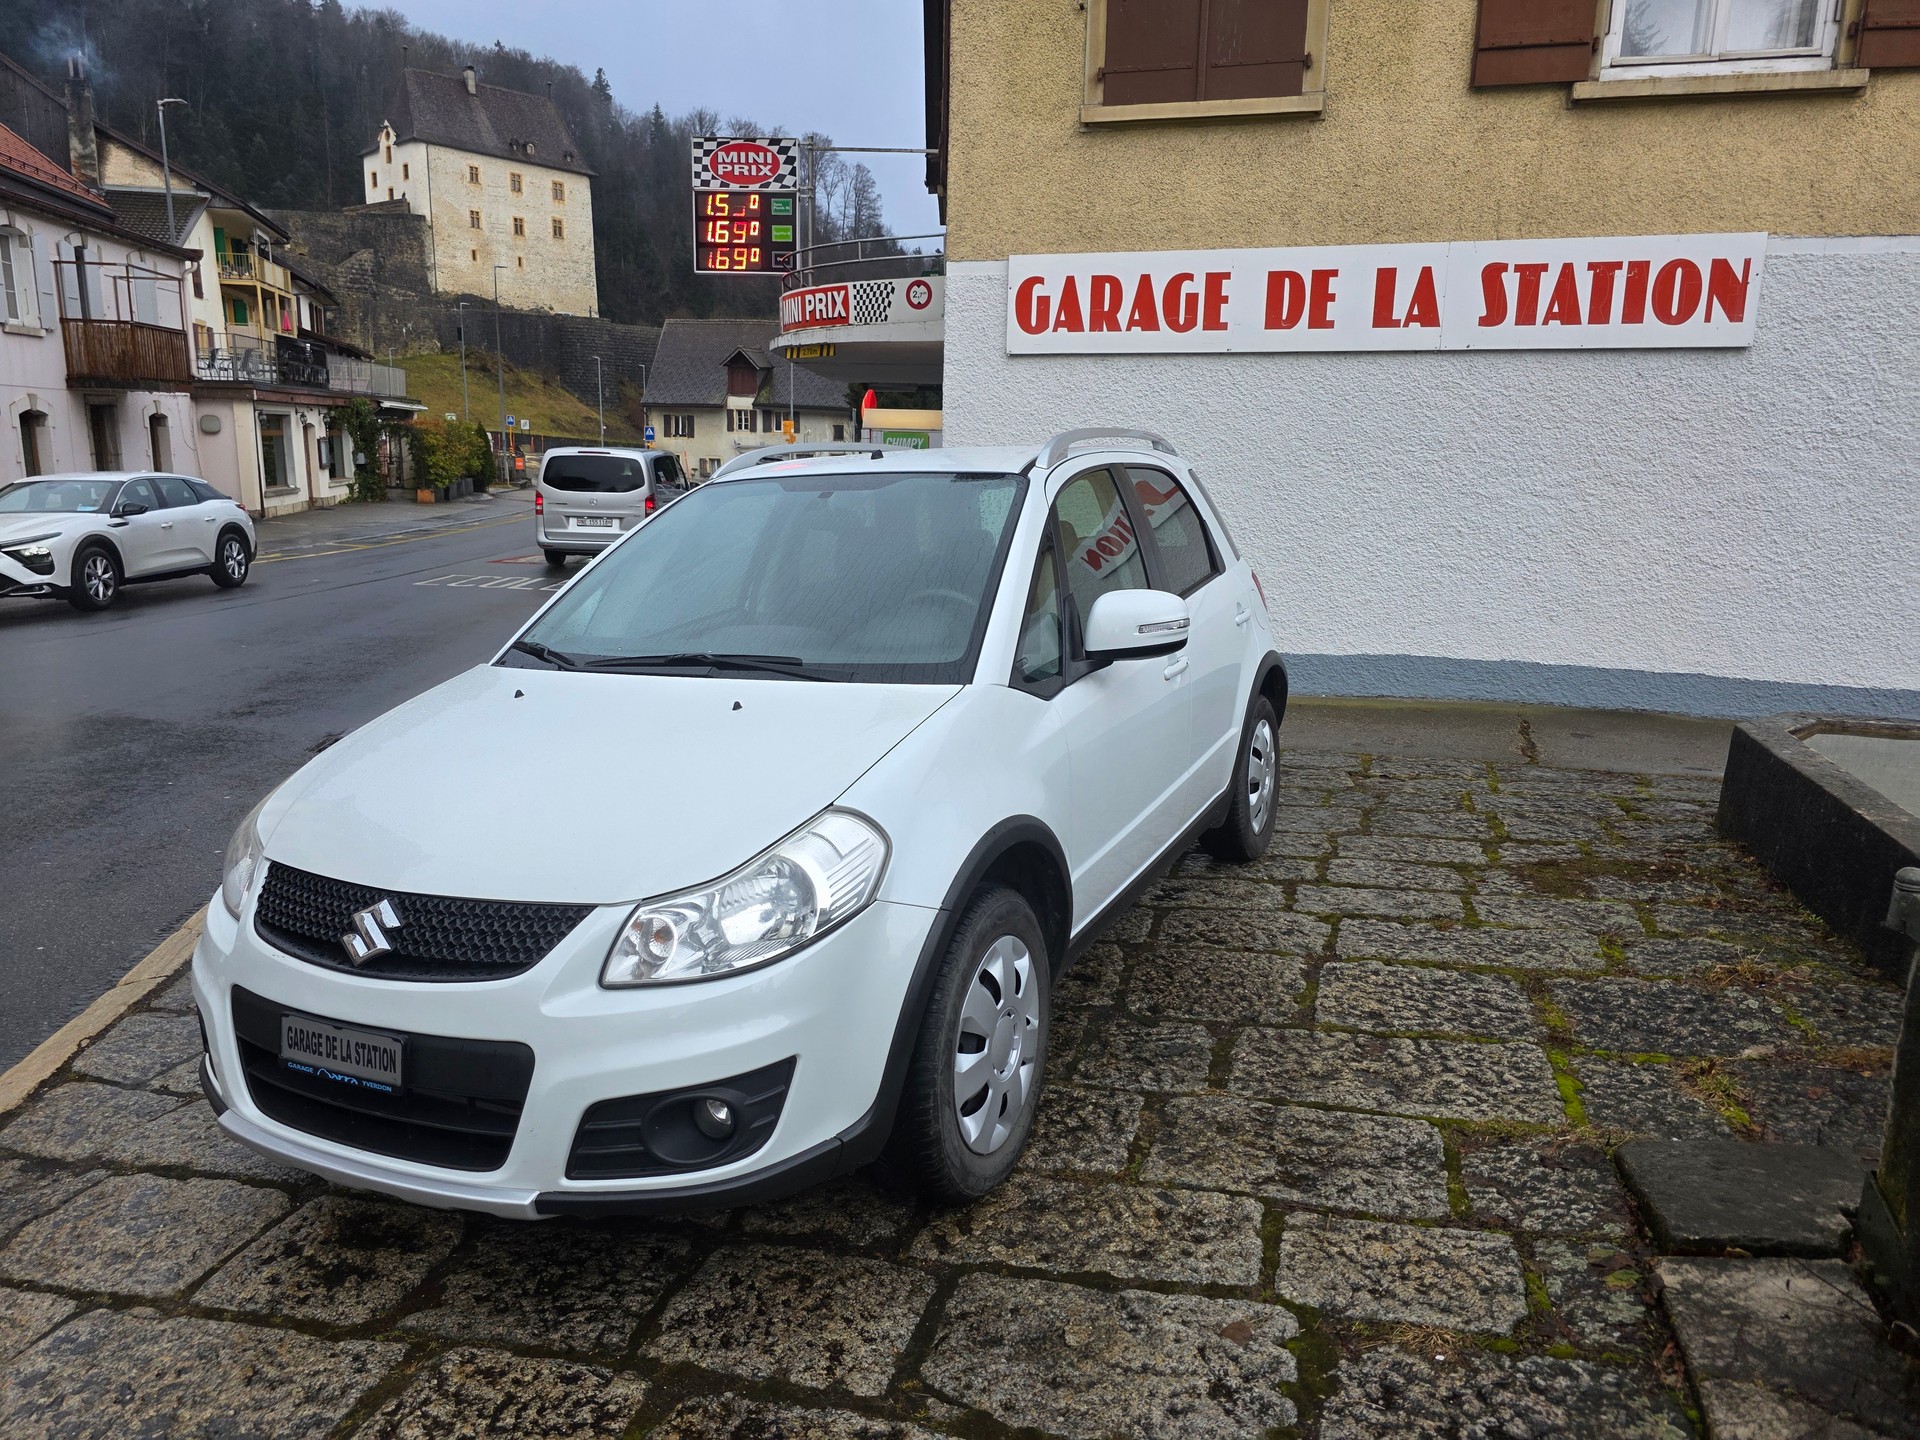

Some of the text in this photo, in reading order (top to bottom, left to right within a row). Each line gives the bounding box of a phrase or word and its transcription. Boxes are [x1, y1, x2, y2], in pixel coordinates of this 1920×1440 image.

[717, 151, 773, 164] MINI
[717, 164, 773, 176] PRIX
[783, 290, 847, 326] MINI PRIX
[1014, 257, 1752, 335] GARAGE DE LA STATION
[886, 437, 925, 450] CHIMPY
[287, 1025, 397, 1074] GARAGE DE LA STATION
[287, 1061, 314, 1074] GARAGE
[362, 1080, 392, 1093] YVERDON
